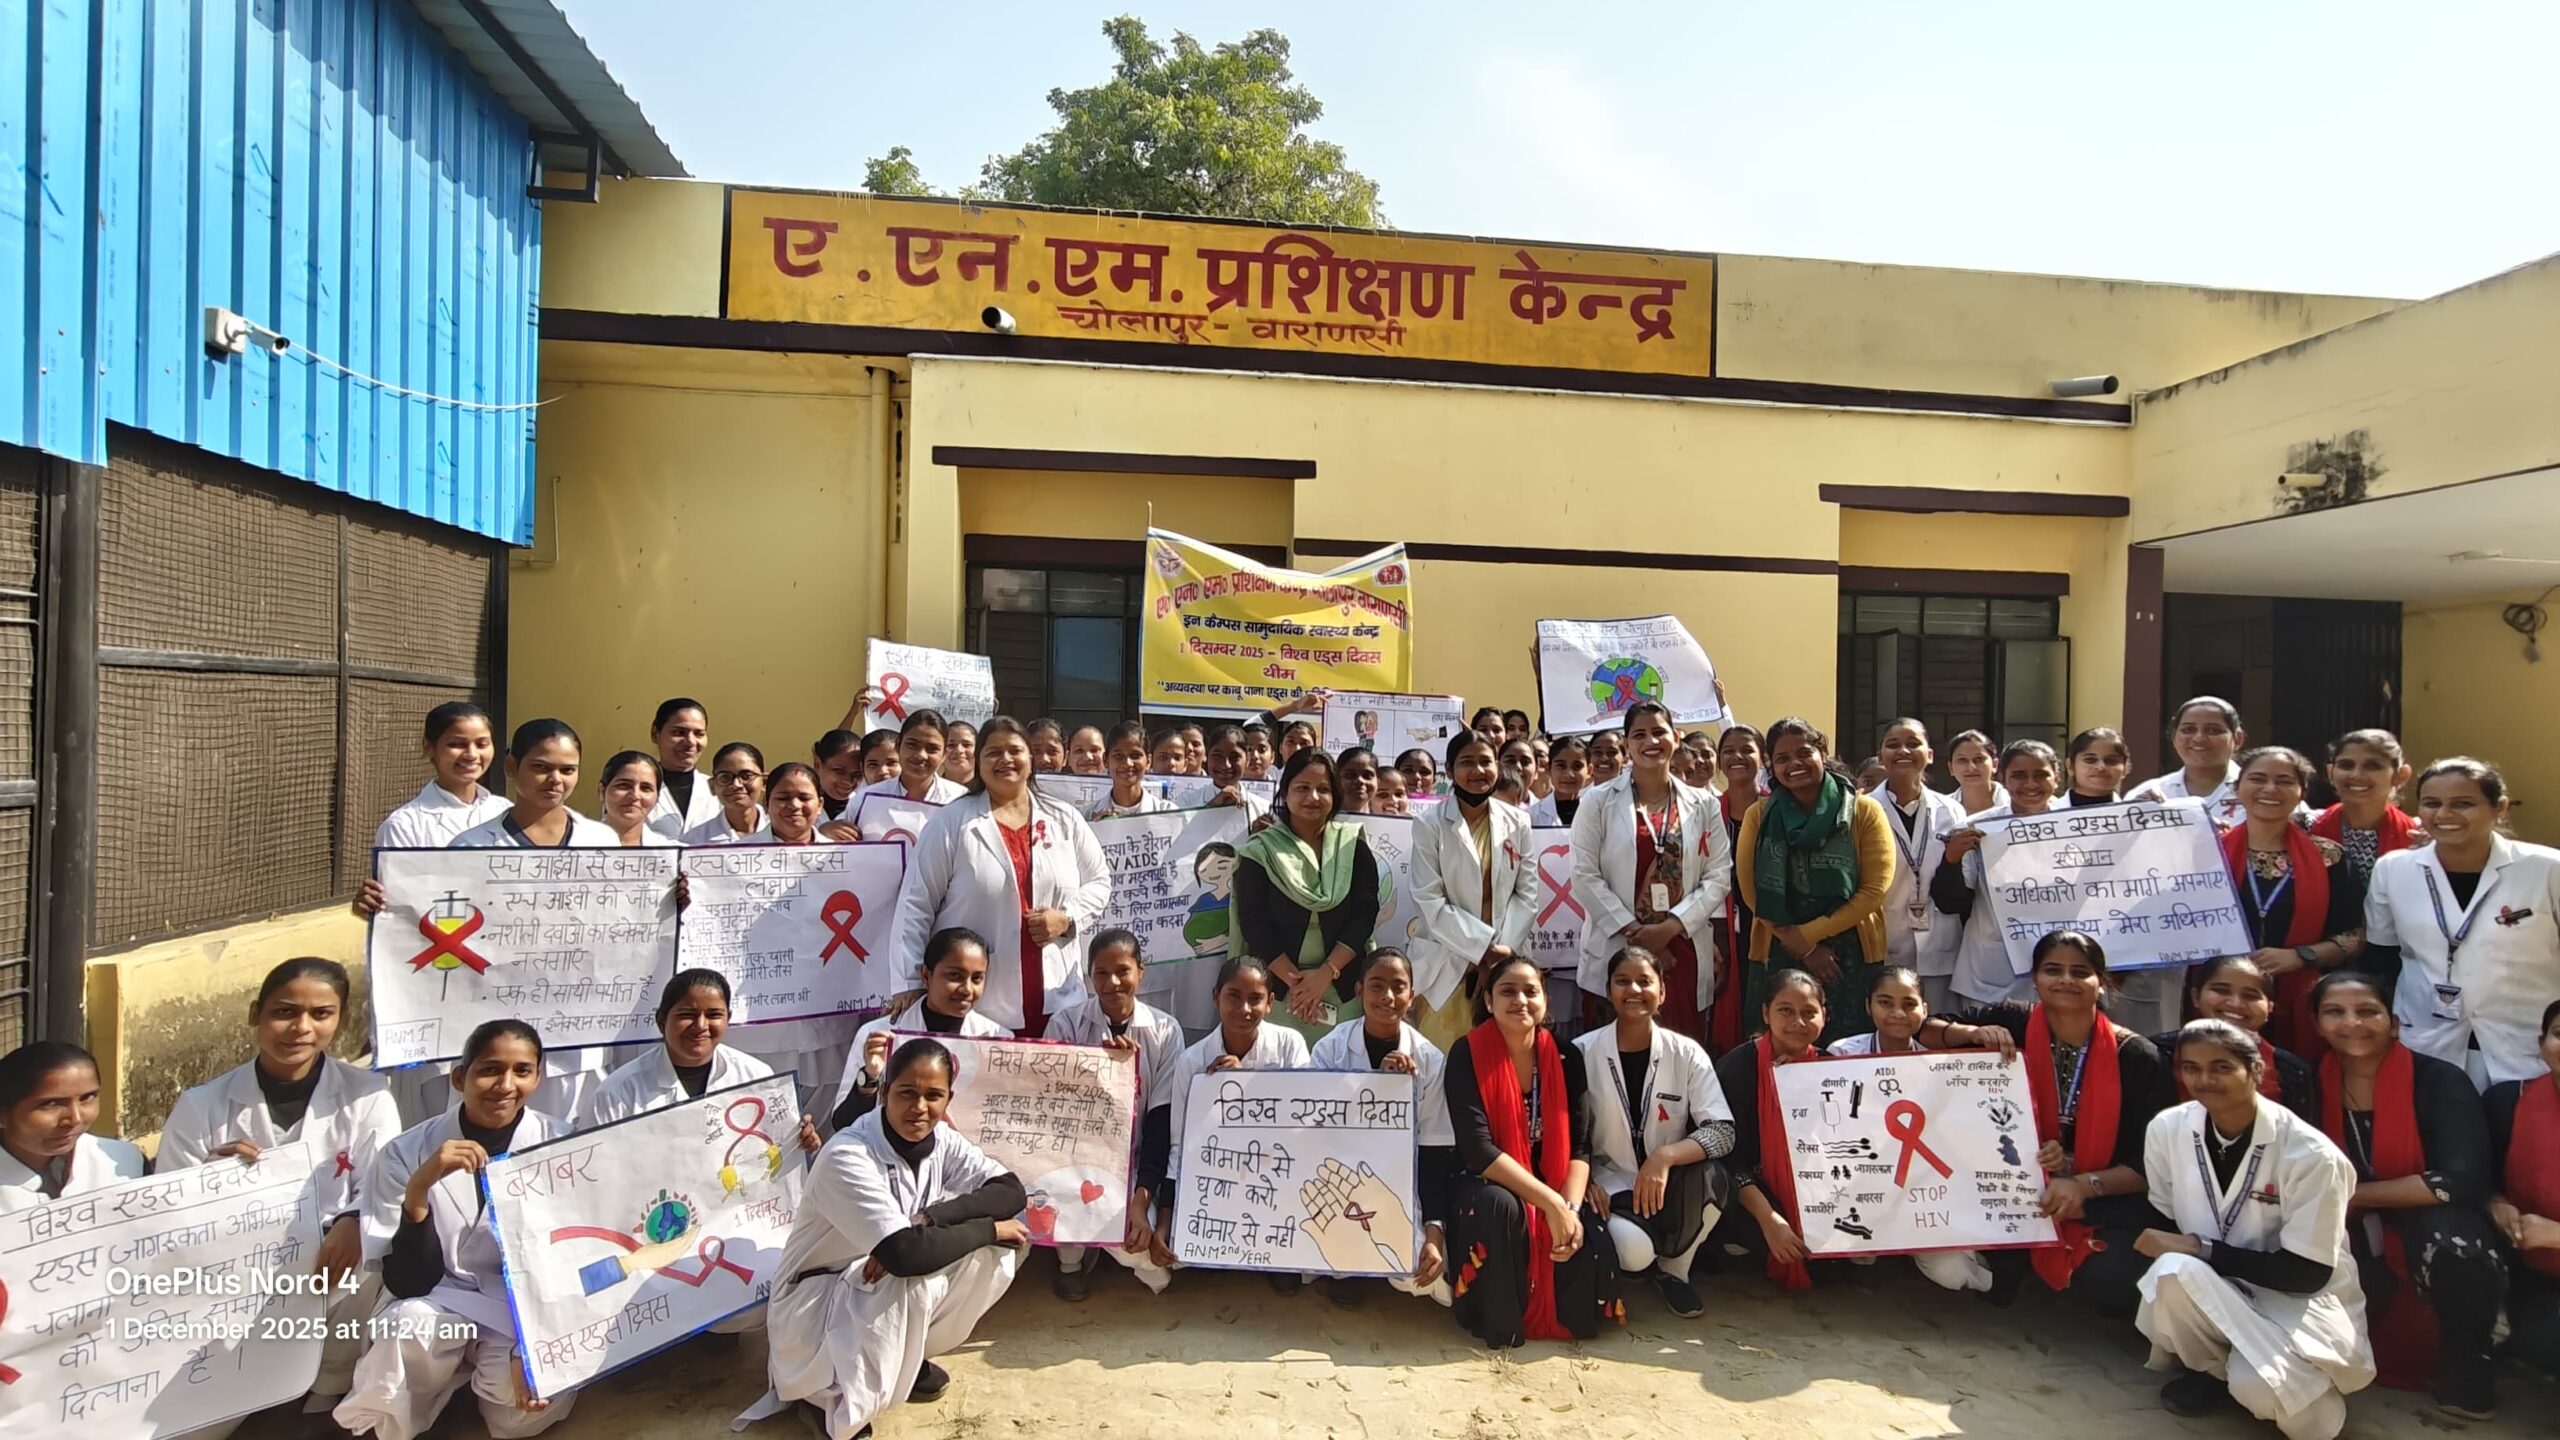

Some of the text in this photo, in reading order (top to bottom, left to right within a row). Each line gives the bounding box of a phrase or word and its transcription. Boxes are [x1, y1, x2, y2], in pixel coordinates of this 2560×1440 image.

[1197, 233, 1476, 322] प्रशिक्षण
[1500, 248, 1687, 344] केन्द्र
[1246, 317, 1407, 352] वाराणसी
[1183, 614, 1201, 629] इन
[1244, 618, 1305, 640] सामुदायिक
[1352, 621, 1380, 639] केन्द्र
[1189, 635, 1238, 656] दिसम्बर
[1240, 645, 1264, 659] 2025
[1280, 643, 1310, 661] विश्व
[1313, 649, 1343, 668] एड्स
[1346, 646, 1382, 664] दिवस
[1263, 662, 1297, 681] थीम
[1208, 684, 1220, 695] पर
[1222, 684, 1243, 701] काबू
[1244, 686, 1264, 697] पाना
[1267, 686, 1288, 701] एड्स
[1290, 684, 1303, 698] की
[2006, 818, 2059, 844] विश्व
[2122, 806, 2188, 832] दिवस
[585, 849, 610, 878] से
[1124, 851, 1159, 870] AIDS
[596, 883, 622, 909] की
[744, 875, 809, 898] लक्षण
[1151, 881, 1173, 898] की
[2084, 867, 2162, 899] का मार्ग
[487, 916, 541, 947] नशीली
[587, 922, 609, 943] का
[2006, 909, 2150, 941] मेरा मेरा
[530, 977, 552, 1004] ही
[552, 976, 594, 1004] साथी
[837, 997, 864, 1011] ANM
[987, 1045, 1025, 1075] विश्व
[1875, 1067, 1896, 1077] AIDS
[1214, 1080, 1283, 1126] विश्व
[1356, 1088, 1412, 1129] दिवस
[505, 1141, 605, 1202] बराबर
[1200, 1134, 1296, 1180] बीमारी से
[19, 1197, 104, 1243] विश्व
[198, 1157, 271, 1196] दिवस
[1194, 1175, 1239, 1207] घृणा
[1907, 1184, 1949, 1204] STOP
[108, 1219, 219, 1266] जागरूकता
[224, 1197, 309, 1238] अभियान
[1187, 1208, 1238, 1245] बीमार
[1241, 1212, 1261, 1248] से
[1914, 1210, 1951, 1229] HIV
[1220, 1244, 1240, 1255] 2nd
[1238, 1248, 1272, 1265] YEAR
[58, 1331, 104, 1369] को
[60, 1344, 216, 1424] दिलाना है
